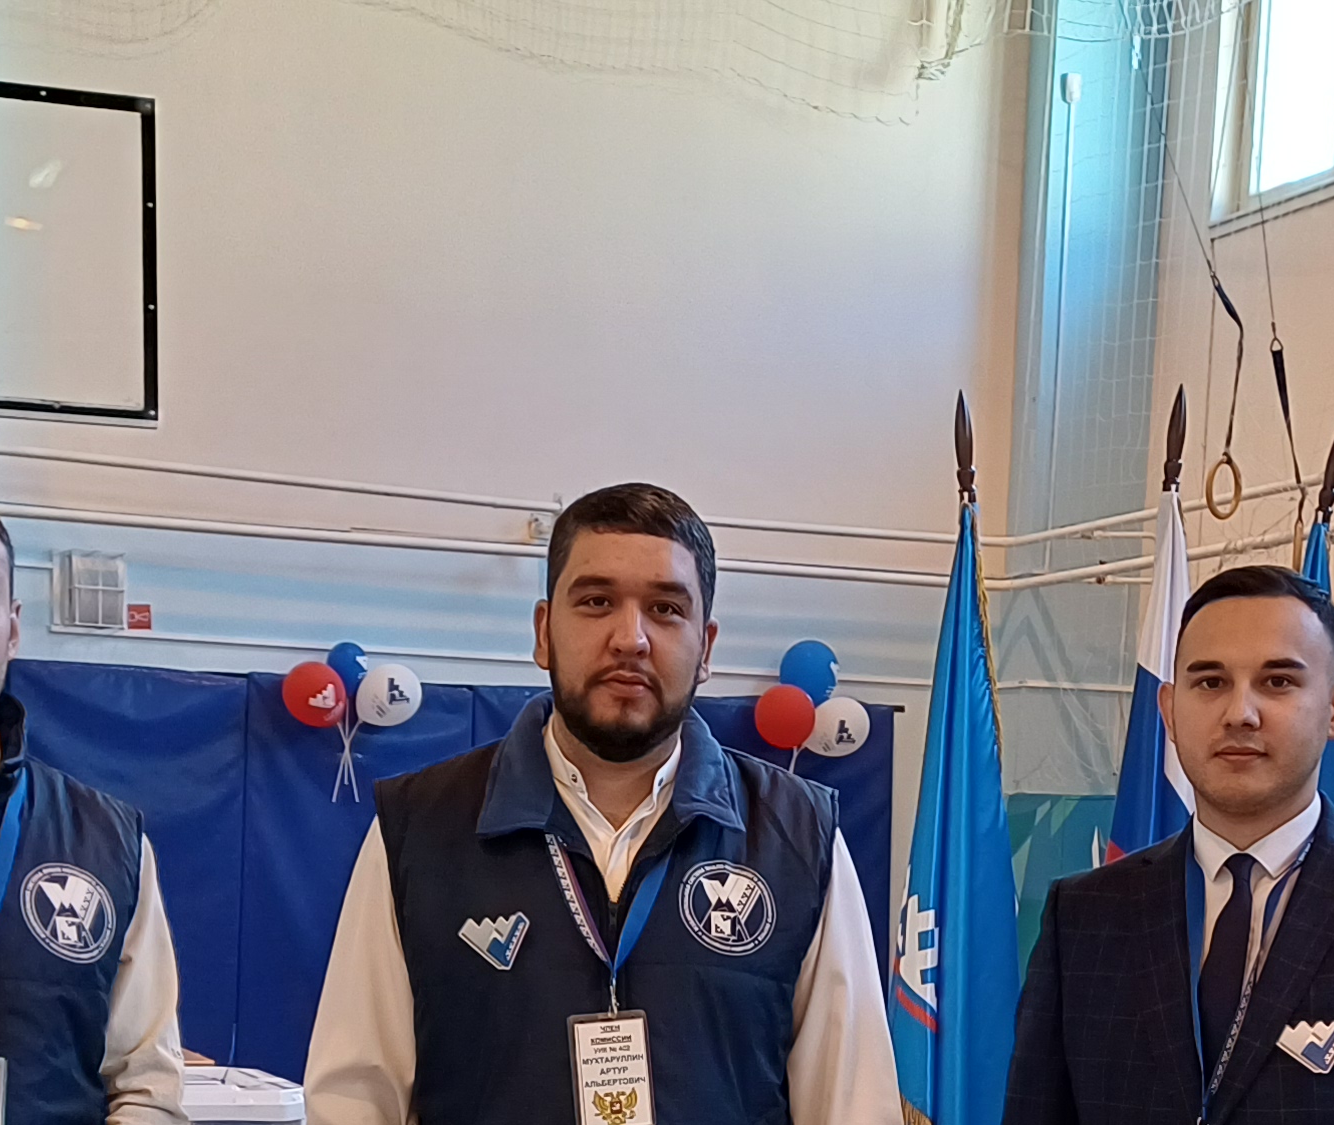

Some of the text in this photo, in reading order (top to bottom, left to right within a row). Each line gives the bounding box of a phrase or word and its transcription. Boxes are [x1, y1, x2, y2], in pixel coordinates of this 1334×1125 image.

[582, 1054, 644, 1065] МУХТАРУЛЛИН
[599, 1066, 629, 1076] АРТУР
[584, 1077, 646, 1088] АЛЬБЕРТОВИЧ
